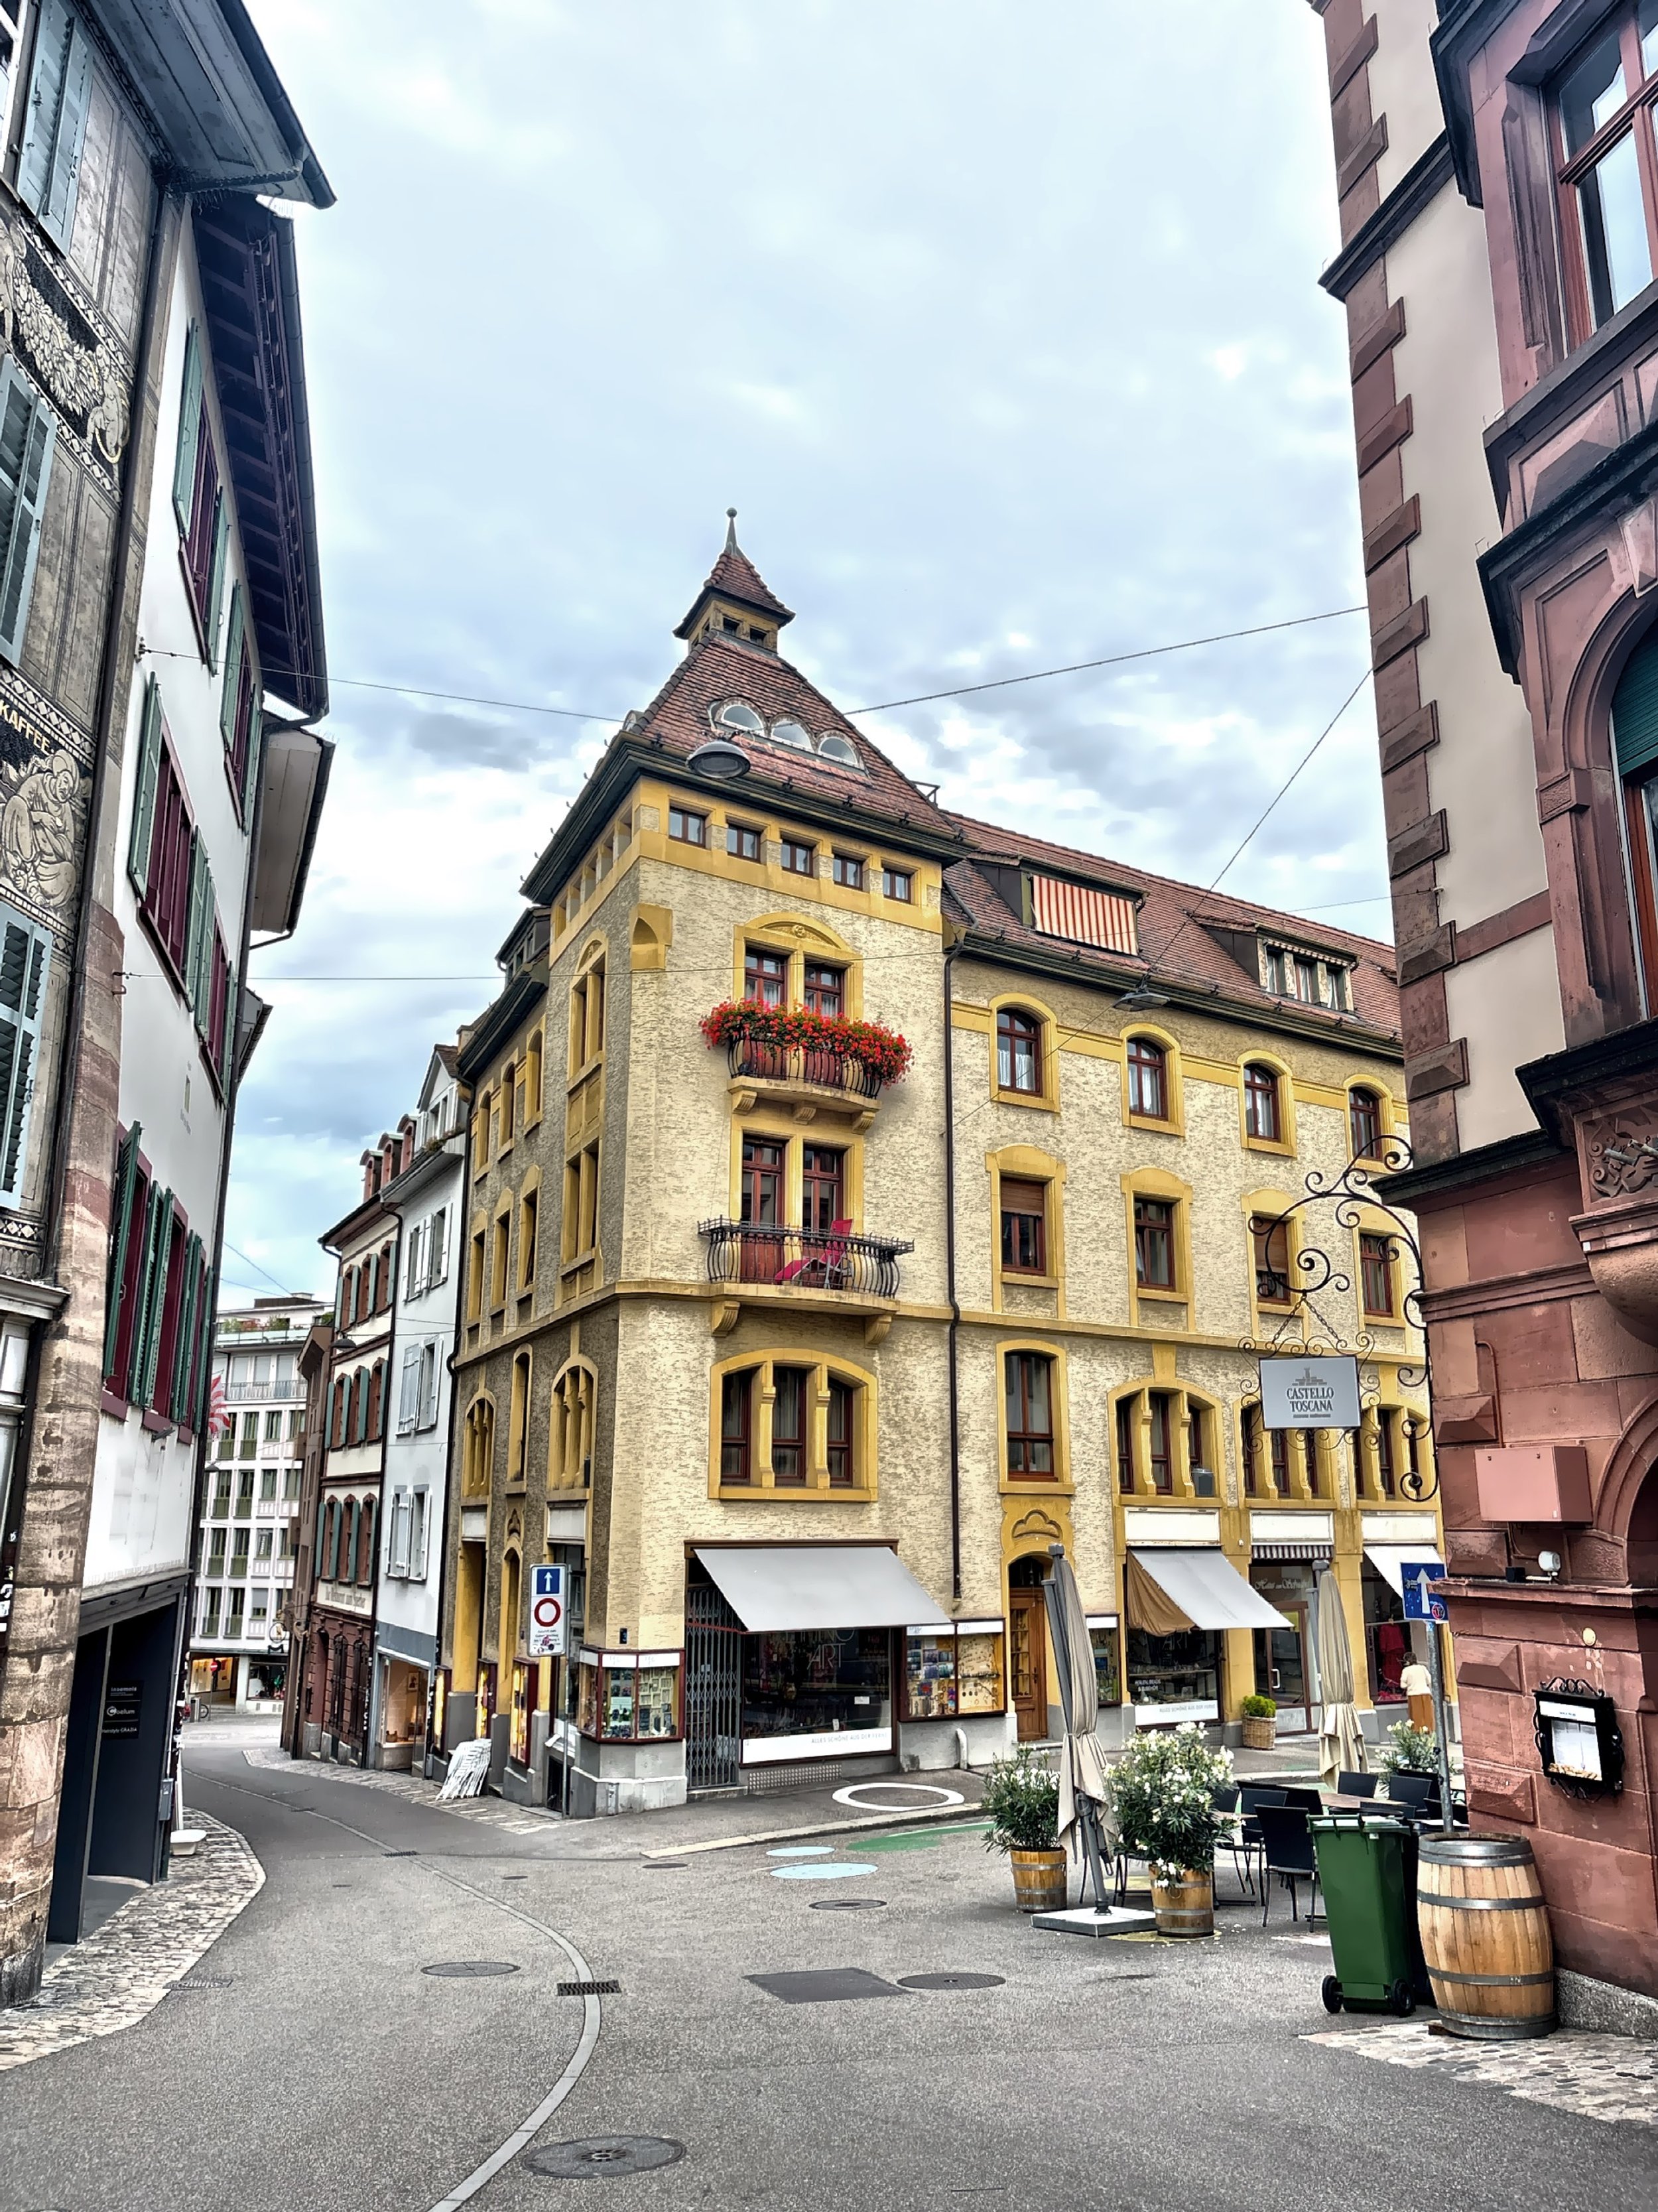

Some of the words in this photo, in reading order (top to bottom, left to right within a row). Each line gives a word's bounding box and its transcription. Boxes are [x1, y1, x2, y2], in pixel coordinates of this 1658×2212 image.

[1287, 1387, 1334, 1399] CASTELLO
[1289, 1399, 1333, 1412] TOSCANA
[806, 1643, 846, 1670] ART
